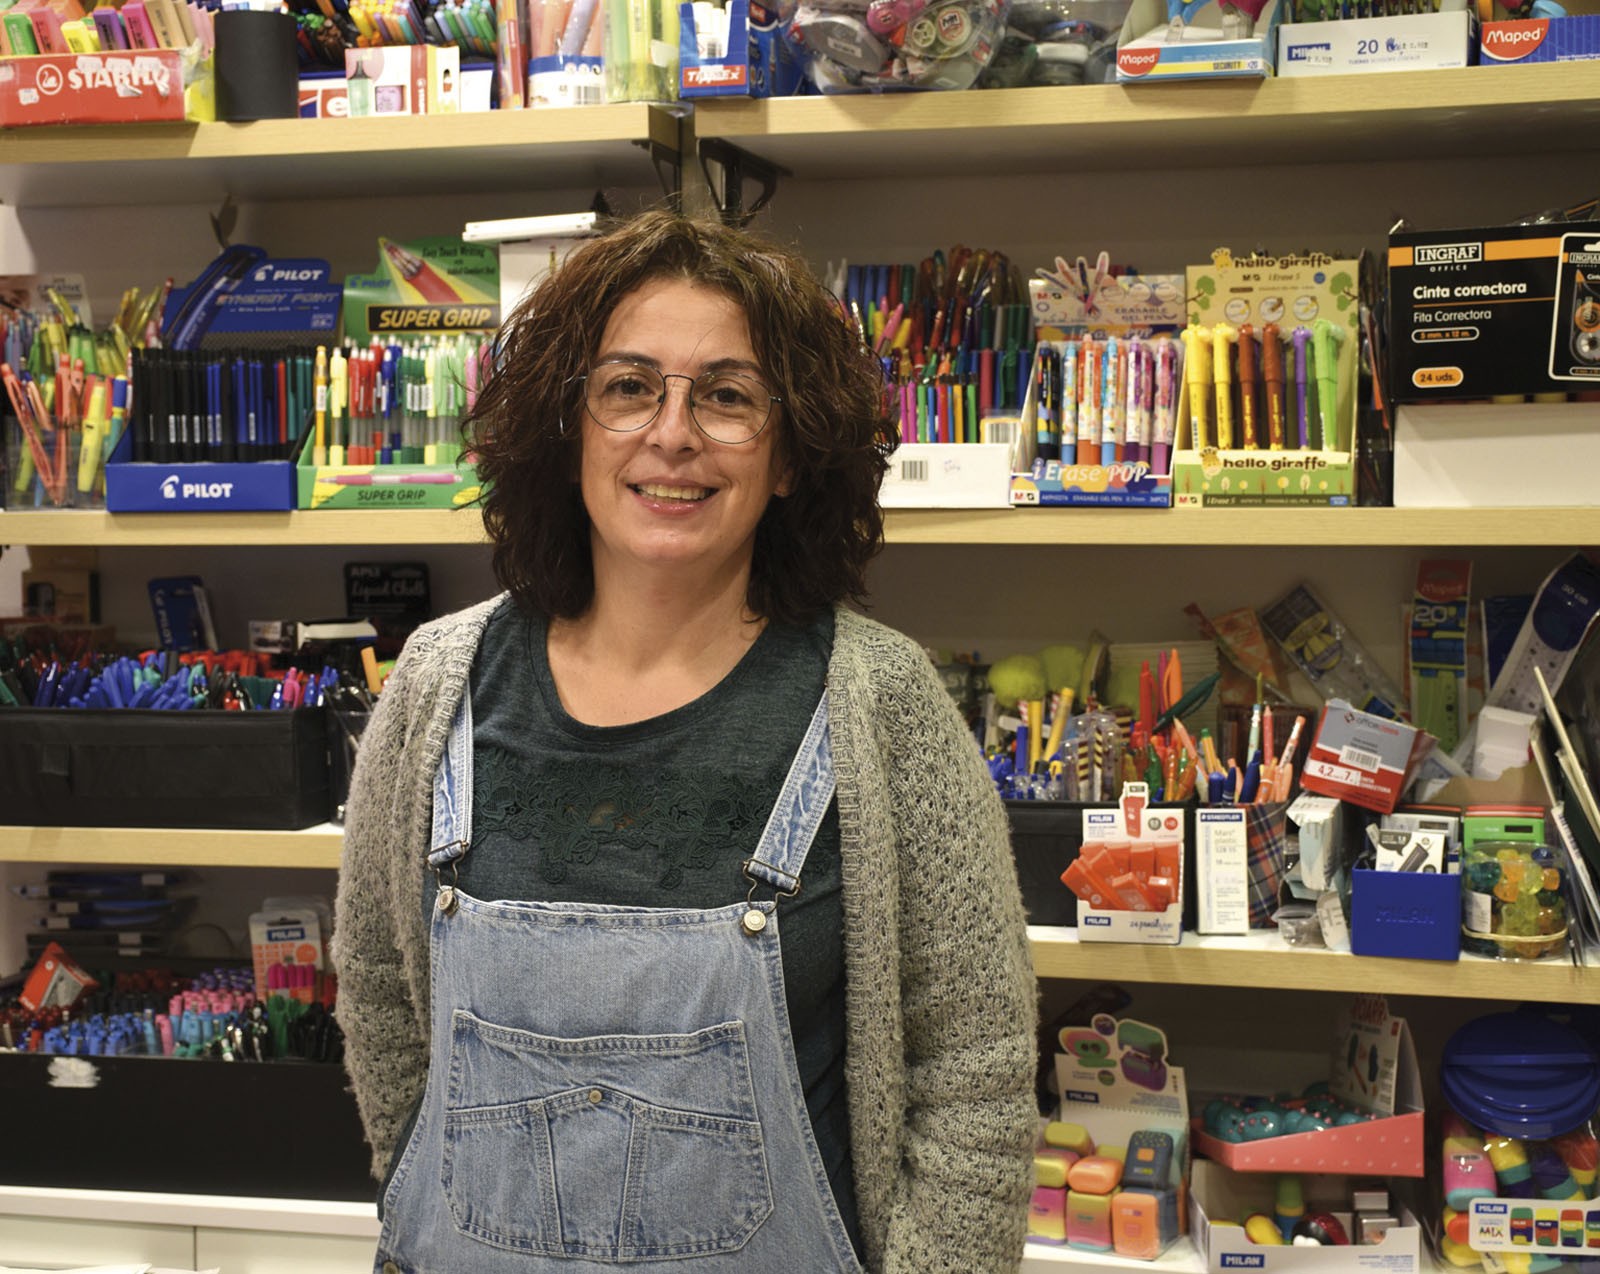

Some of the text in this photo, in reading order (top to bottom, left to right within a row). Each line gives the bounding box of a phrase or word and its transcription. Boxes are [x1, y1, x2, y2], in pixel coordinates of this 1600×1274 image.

[1486, 27, 1541, 45] Maped
[1357, 39, 1379, 55] 20
[1119, 54, 1155, 66] Maped
[1419, 247, 1478, 262] INGRAF
[1234, 253, 1332, 270] hello giraffe
[273, 269, 323, 281] PILOT
[1429, 265, 1468, 273] OFFICE
[361, 279, 391, 288] PILOT
[1413, 282, 1527, 300] Cinta correctora
[378, 307, 493, 328] SUPER GRIP
[1413, 309, 1492, 323] Fita Correctora
[1420, 373, 1433, 382] 24
[1223, 456, 1328, 471] hello giraffe
[1045, 463, 1100, 482] Erase
[1108, 465, 1148, 483] POP
[183, 483, 233, 498] PILOT
[357, 489, 427, 501] SUPER GRIP
[1414, 604, 1448, 623] 20
[1344, 770, 1351, 781] 7
[1090, 815, 1113, 823] MILAN
[1086, 917, 1109, 925] MILAN
[271, 930, 302, 940] MILAN
[1478, 1205, 1505, 1213] MILAN
[1225, 1255, 1260, 1265] MILAN
